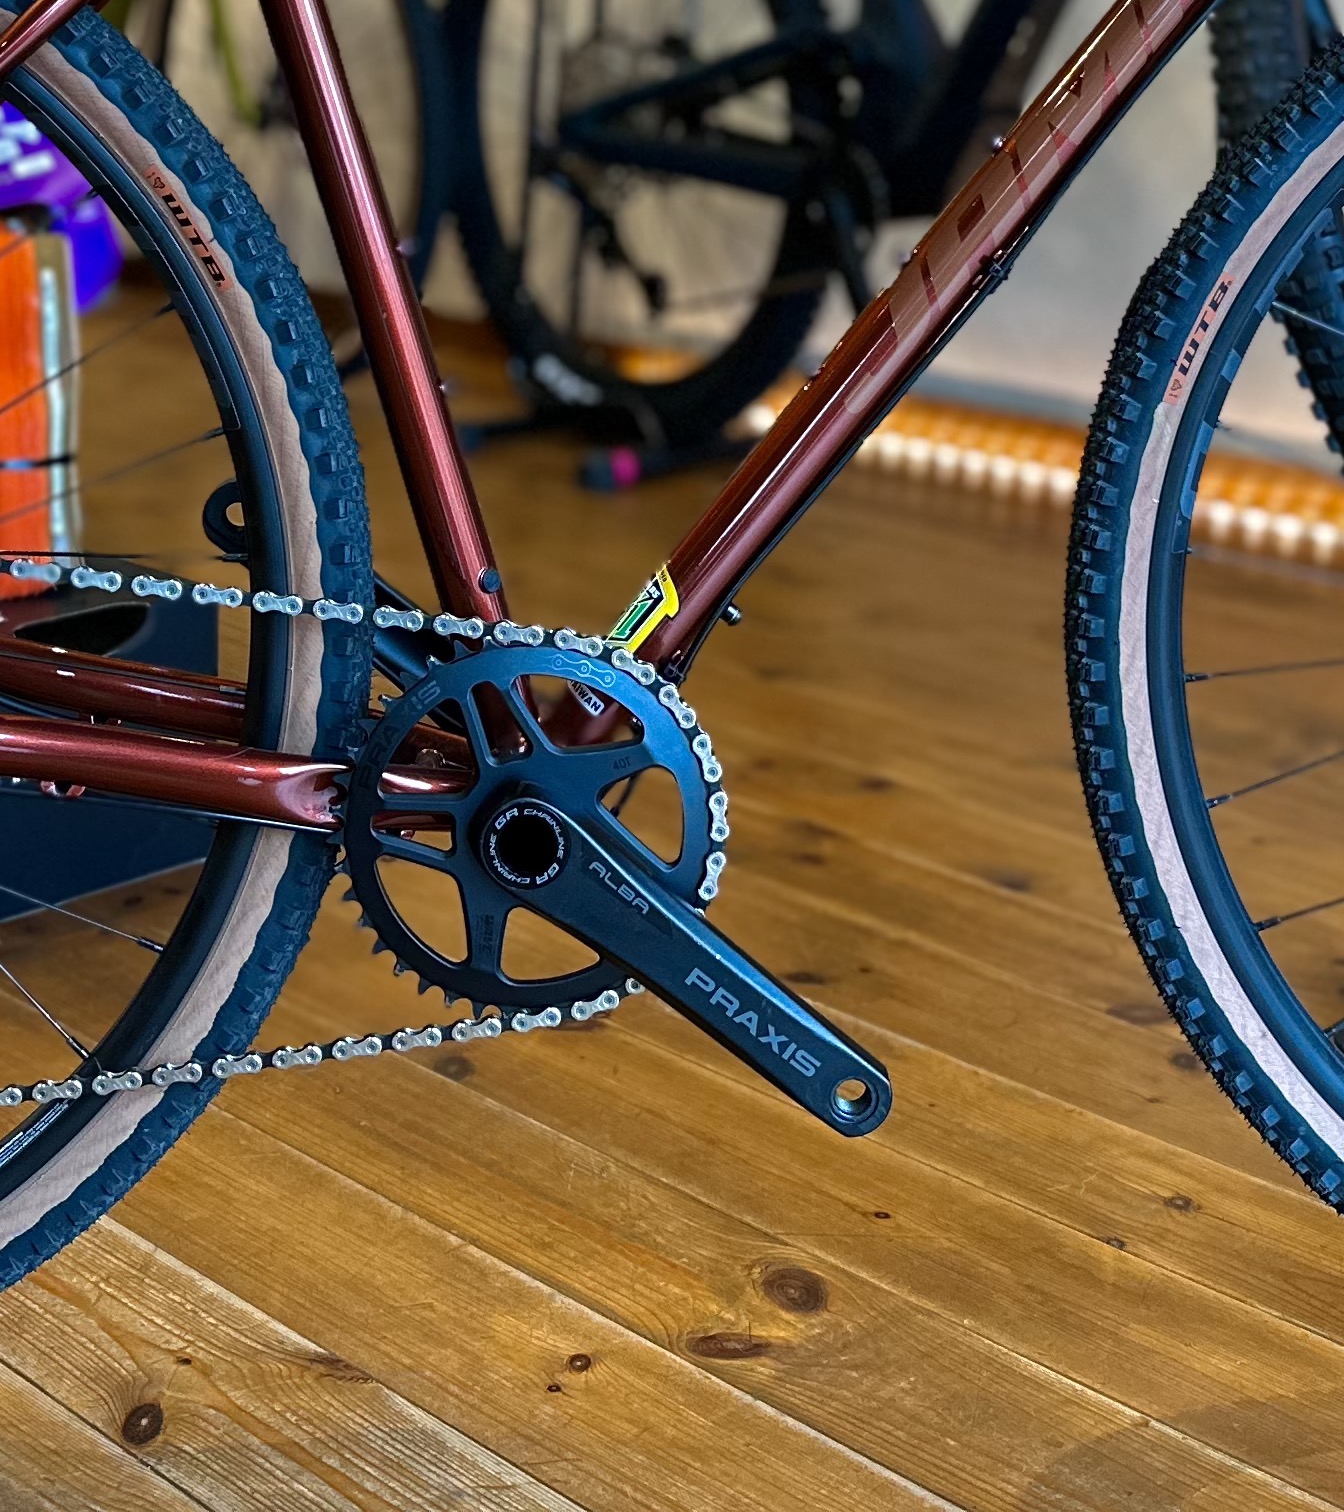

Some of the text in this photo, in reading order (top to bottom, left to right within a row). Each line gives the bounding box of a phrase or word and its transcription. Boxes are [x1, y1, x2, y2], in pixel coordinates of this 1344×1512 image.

[161, 191, 225, 281] WTB
[1177, 281, 1229, 377] WTB
[489, 833, 530, 883] CHAINLINE
[523, 809, 564, 859] CHAINLINE
[588, 860, 649, 916] ALBA
[684, 967, 821, 1078] PRAXIS
